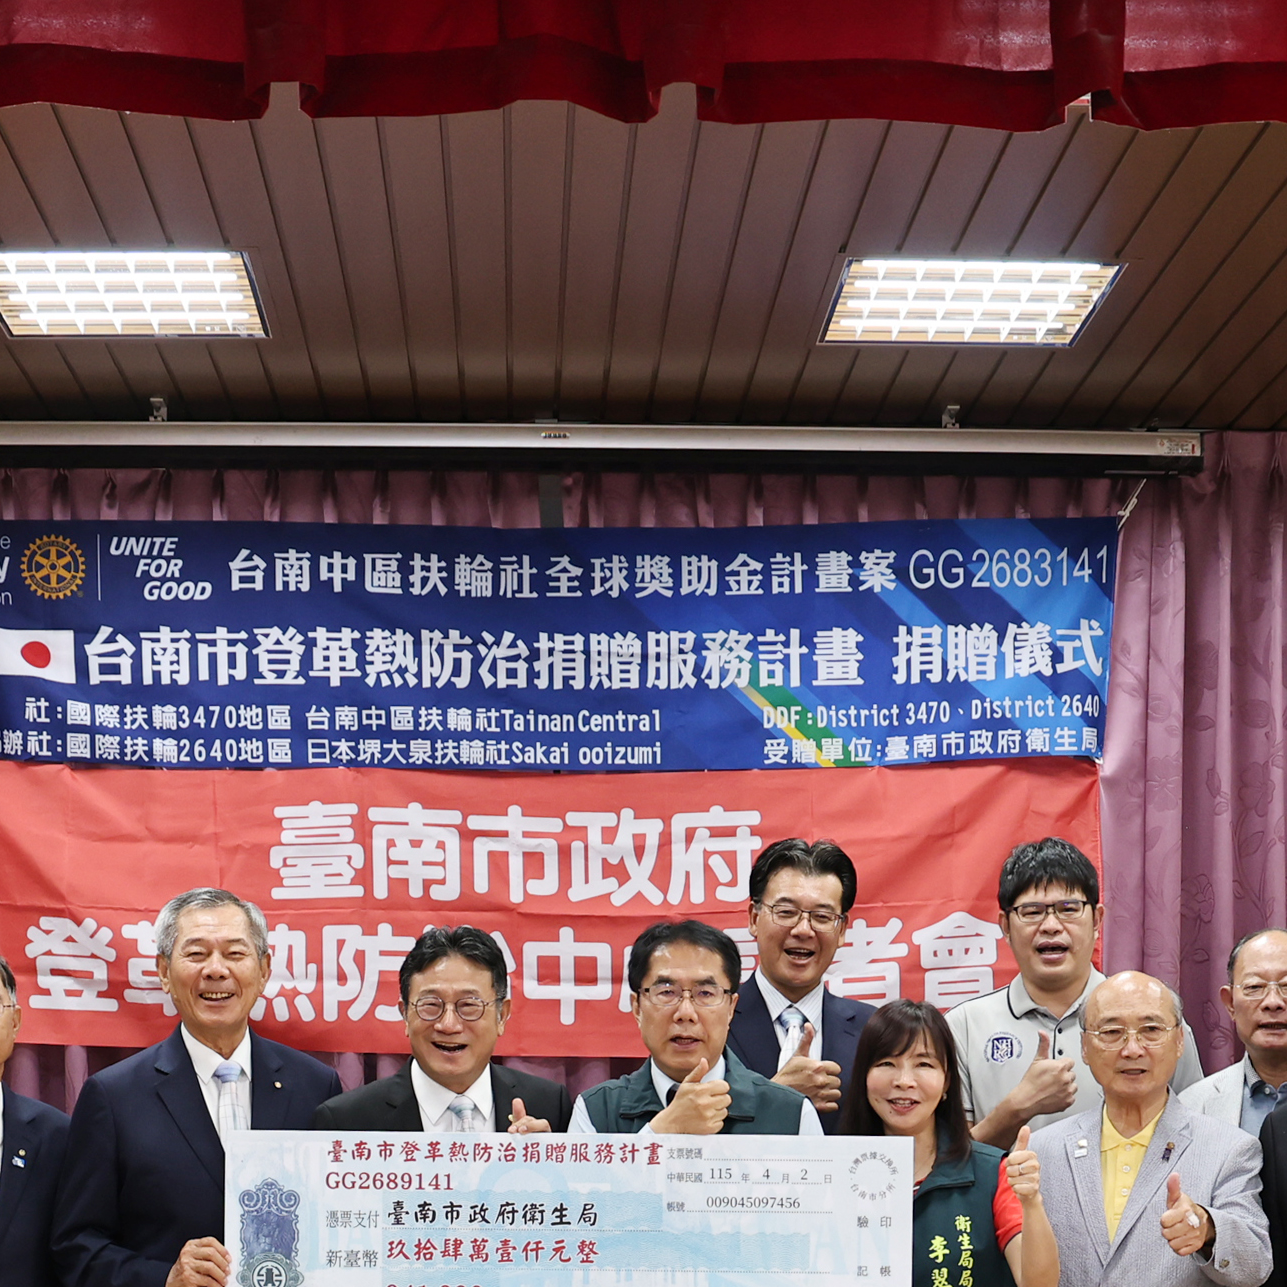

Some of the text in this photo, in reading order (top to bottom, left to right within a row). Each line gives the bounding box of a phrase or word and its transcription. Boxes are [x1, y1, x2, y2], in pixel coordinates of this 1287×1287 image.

[110, 536, 179, 557] UNITE
[135, 558, 183, 578] FOR
[143, 580, 213, 601] GOOD
[893, 618, 1105, 687] 捐贈儀式
[1062, 694, 1100, 718] 2640
[269, 799, 763, 907] 臺南市政府
[327, 1139, 664, 1167] 臺南市登革熱防治捐贈服務計畫
[325, 1171, 454, 1191] GG2689141
[709, 1168, 732, 1180] 115
[762, 1168, 771, 1180] 4
[800, 1168, 809, 1181] 2
[706, 1196, 801, 1209] 009045097456
[325, 1200, 598, 1229] 憑票支付 臺南市政府衛生局
[325, 1238, 599, 1268] 新臺幣 玖拾肆萬壹仟元整
